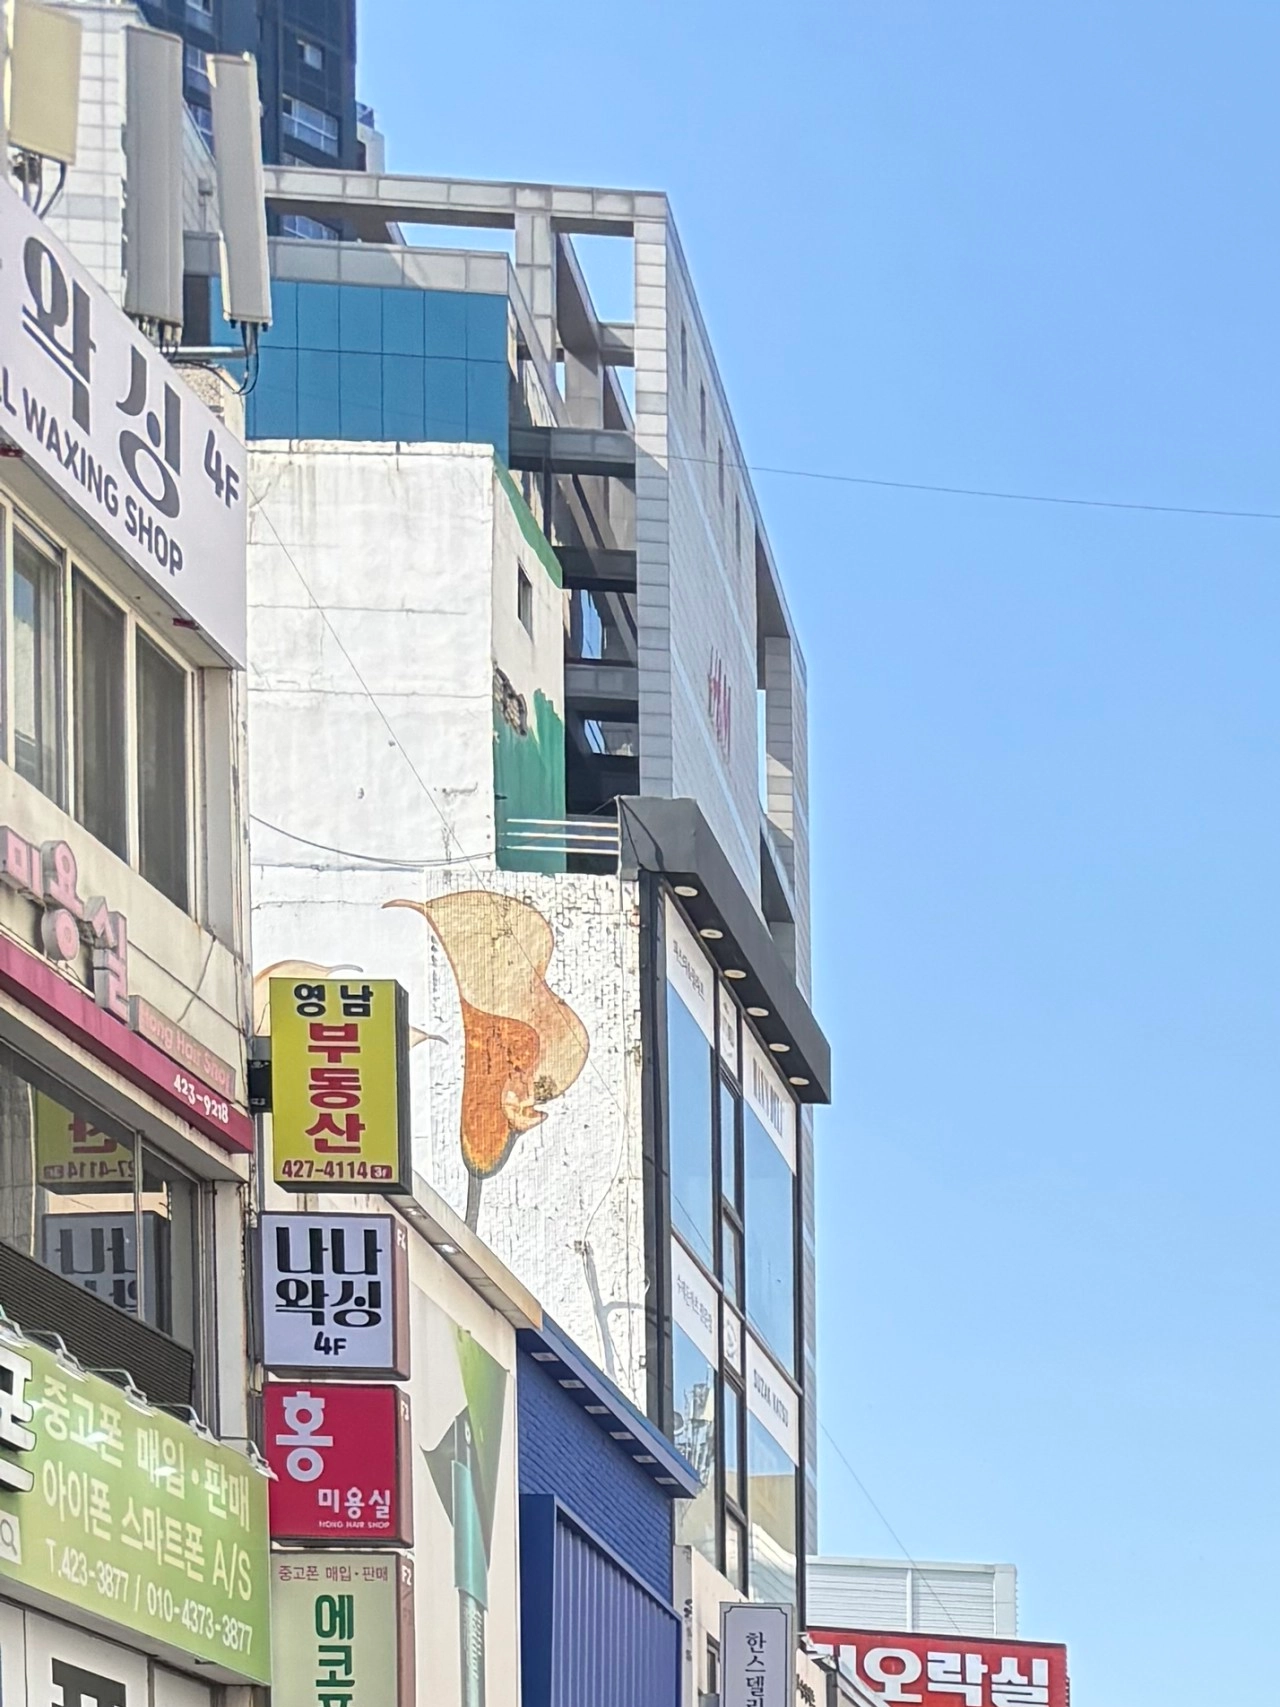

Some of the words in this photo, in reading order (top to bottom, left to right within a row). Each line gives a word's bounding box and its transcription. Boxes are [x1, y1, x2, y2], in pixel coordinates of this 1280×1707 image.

[23, 236, 181, 519] 왁싱
[203, 428, 240, 510] 4F
[22, 387, 119, 518] WAXING
[124, 494, 184, 577] SHOP
[3, 826, 129, 1024] 미용실
[294, 984, 373, 1017] 영남
[173, 1074, 229, 1124] 423-9218
[305, 1023, 366, 1154] 부동산
[282, 1159, 368, 1179] 427-4114
[276, 1226, 382, 1276] 나나
[275, 1278, 382, 1329] 왁싱
[314, 1331, 347, 1356] 4F
[41, 1375, 124, 1468] 중고폰
[276, 1391, 334, 1483] 홍
[42, 1459, 112, 1541] 아이폰
[121, 1496, 204, 1583] 스마트폰
[212, 1539, 251, 1601] A/S
[318, 1486, 391, 1520] 미용실
[278, 1565, 319, 1583] 중고폰
[147, 1582, 253, 1655] 010-4373-3877
